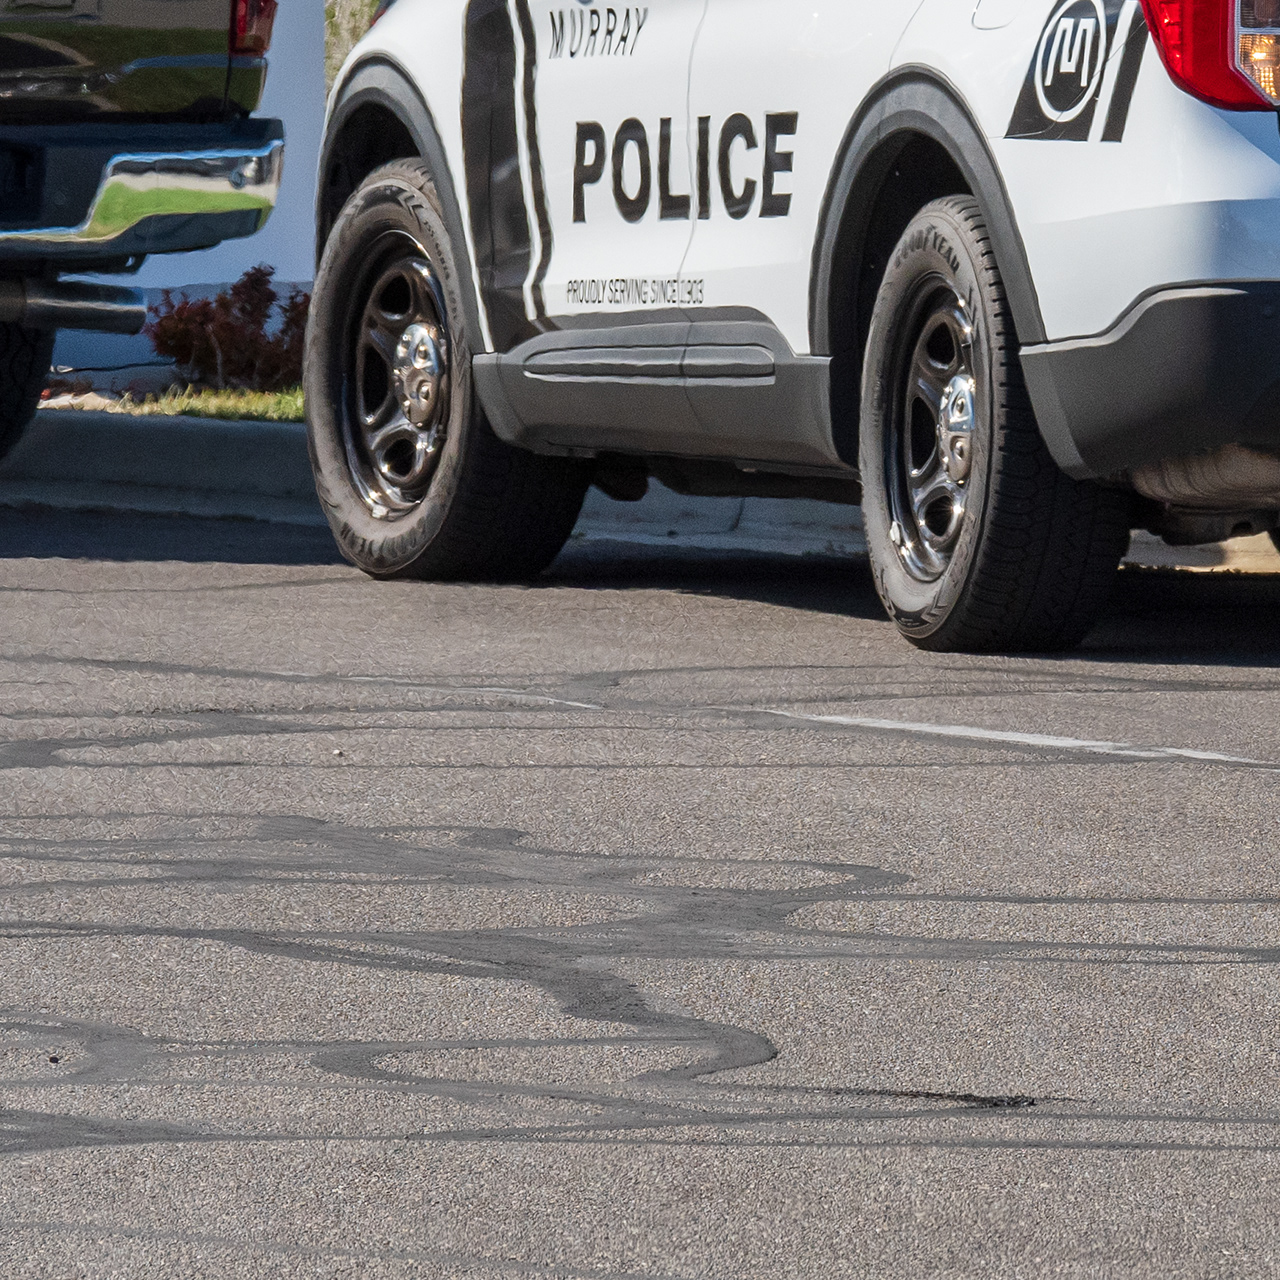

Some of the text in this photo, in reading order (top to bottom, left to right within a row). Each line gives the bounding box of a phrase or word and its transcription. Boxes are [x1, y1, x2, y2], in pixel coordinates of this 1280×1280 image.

[549, 6, 649, 60] MURRAY
[573, 110, 799, 225] POLICE
[567, 278, 607, 304] PROUDLY
[608, 278, 648, 304] SERVING
[649, 279, 678, 304] SINCE
